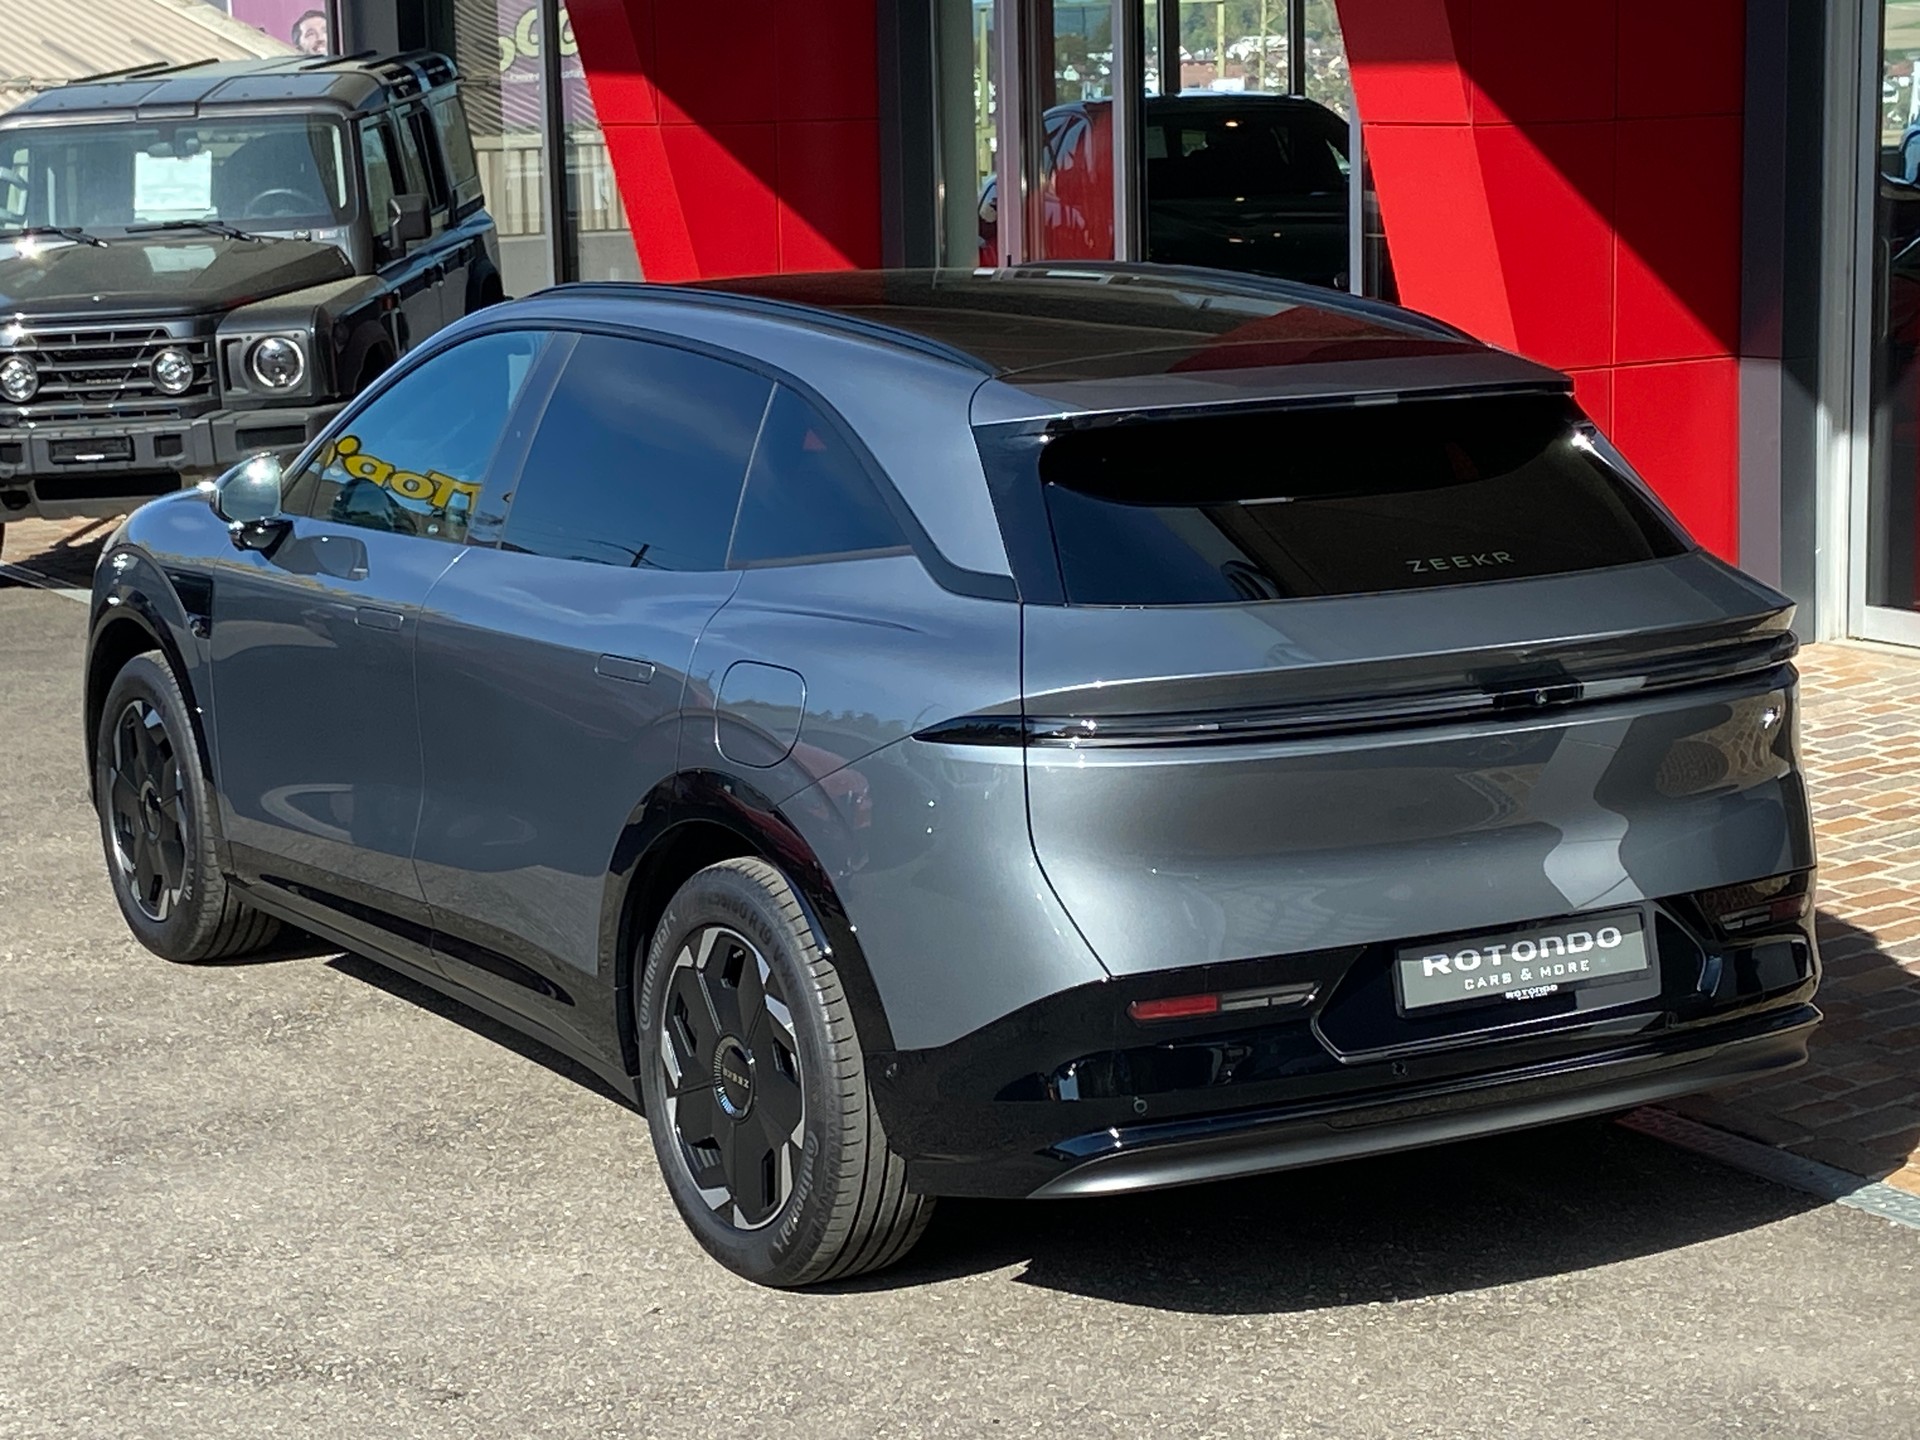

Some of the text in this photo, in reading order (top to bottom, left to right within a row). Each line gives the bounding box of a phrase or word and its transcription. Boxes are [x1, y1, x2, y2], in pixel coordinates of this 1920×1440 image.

[1405, 551, 1515, 573] ZEEKR
[638, 917, 674, 1031] Continental
[1422, 926, 1622, 977] ROTONDO
[1464, 959, 1590, 990] CARS & MORE
[779, 1130, 820, 1246] Continental
